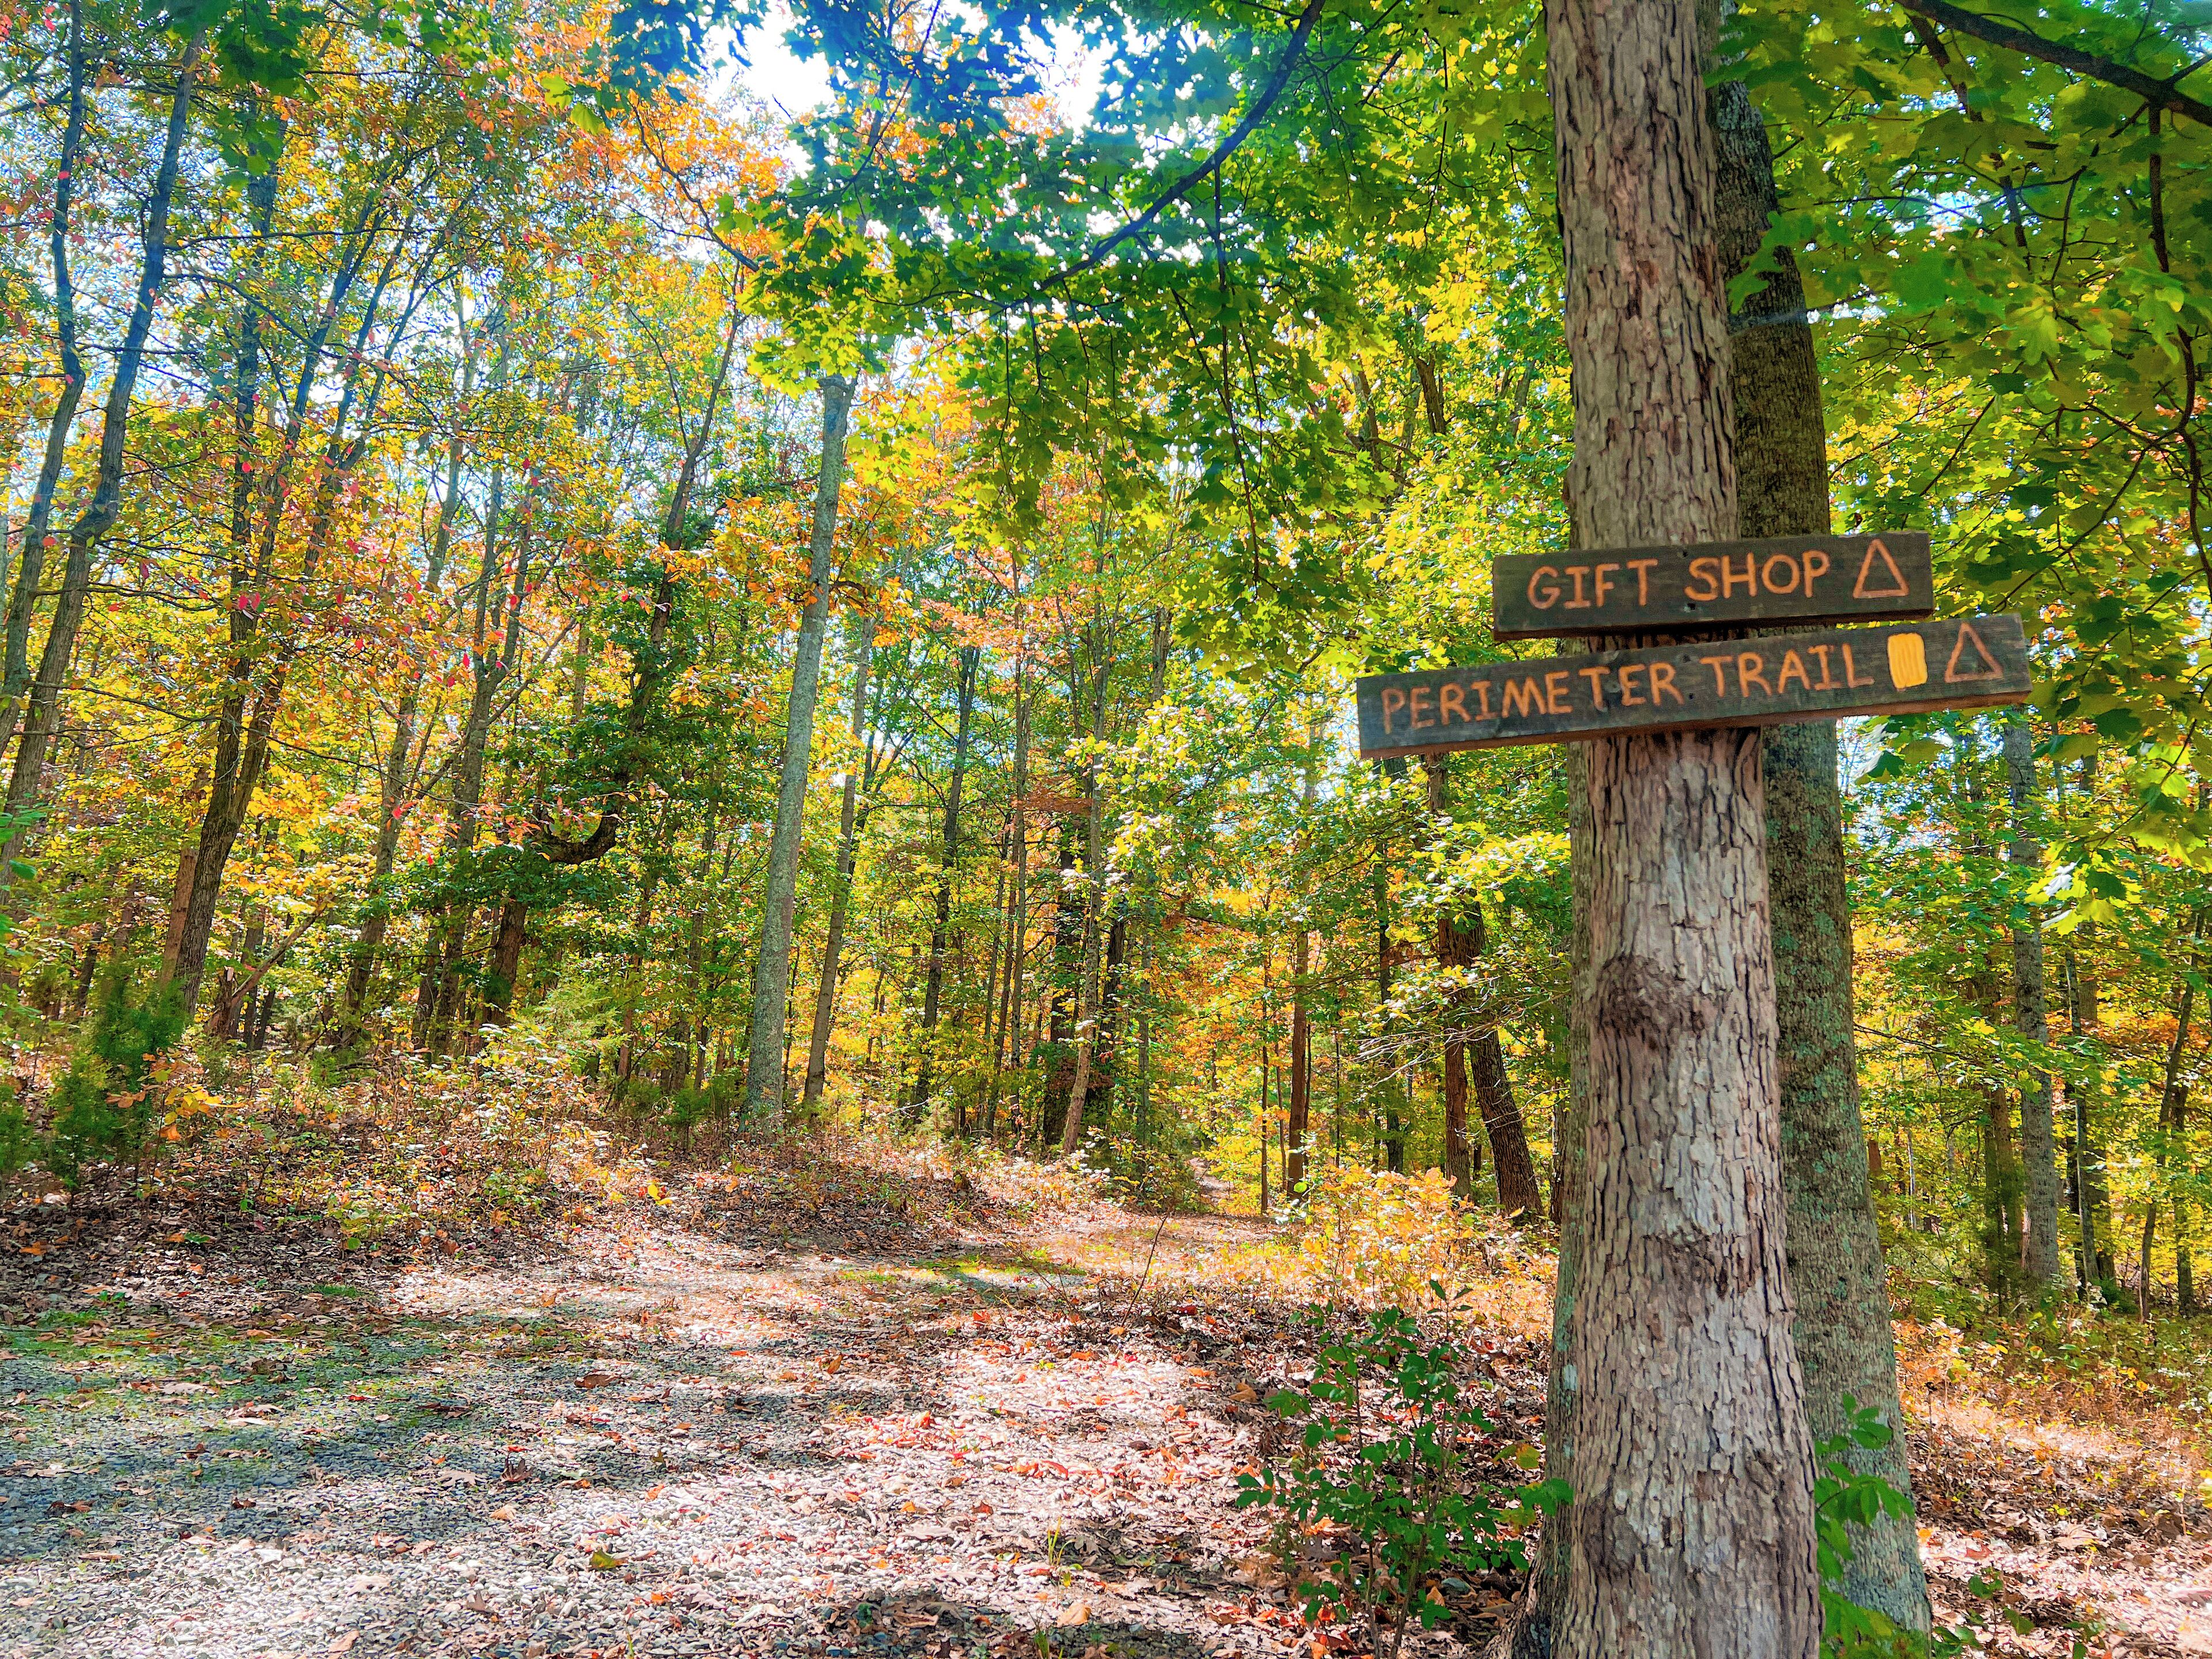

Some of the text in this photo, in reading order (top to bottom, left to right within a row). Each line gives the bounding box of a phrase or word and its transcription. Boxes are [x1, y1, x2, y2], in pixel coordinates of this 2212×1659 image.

[1527, 549, 1831, 609] GIFT SHOP
[1382, 643, 1875, 734] PERIMETER TRAIL
